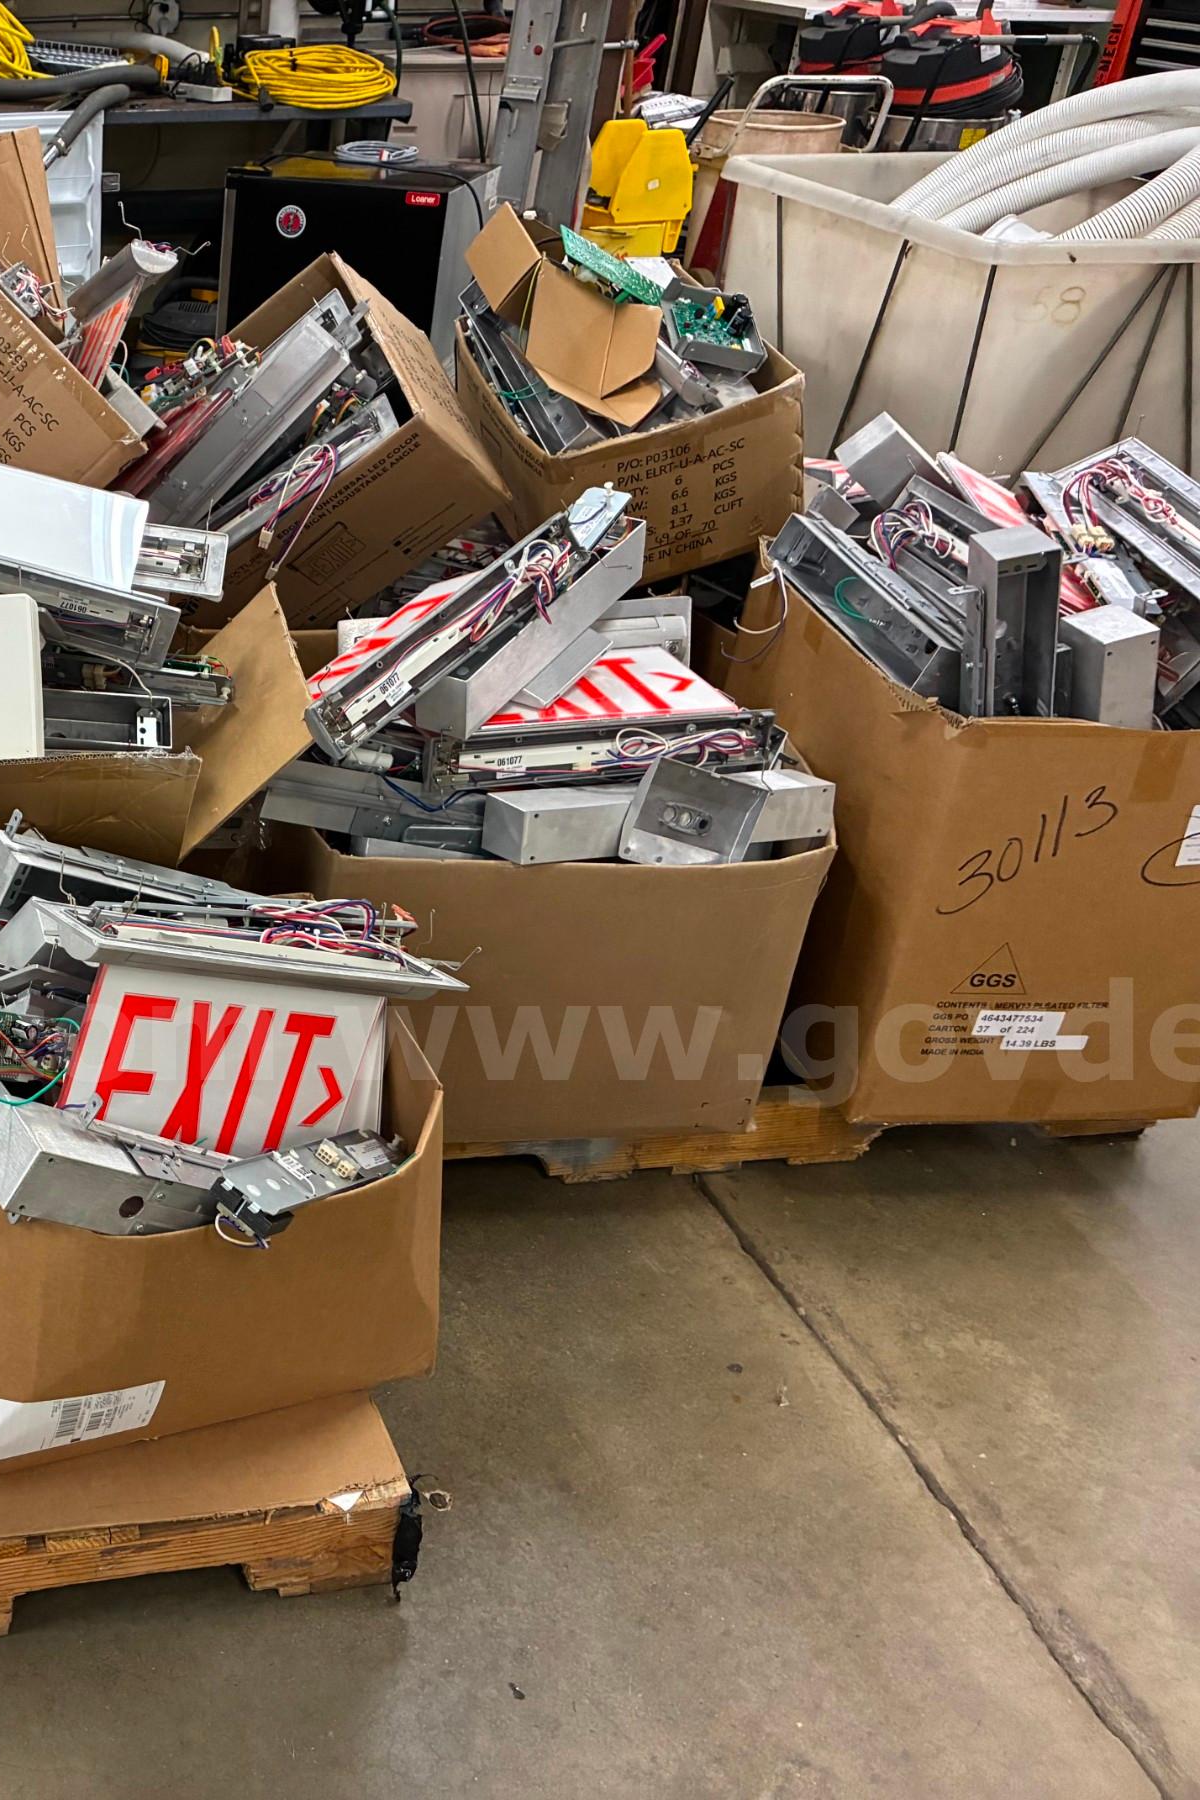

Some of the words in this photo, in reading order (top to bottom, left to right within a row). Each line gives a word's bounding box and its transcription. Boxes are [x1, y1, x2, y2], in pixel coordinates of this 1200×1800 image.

[411, 194, 436, 204] Loaner
[13, 412, 38, 437] PCS
[2, 427, 27, 454] KGS
[367, 458, 386, 473] LED
[386, 431, 419, 460] COLOR
[645, 442, 692, 466] P03106
[332, 465, 389, 512] ADJUSTABLE
[390, 442, 421, 469] ANGLE
[674, 474, 683, 486] 6
[712, 457, 736, 474] PCS
[671, 487, 689, 501] 6.6
[714, 471, 737, 487] KGS
[671, 502, 688, 516] 8.1
[713, 486, 736, 502] KGS
[669, 514, 693, 530] 1.37
[713, 498, 744, 516] CUFT
[675, 528, 692, 541] OF
[701, 519, 716, 532] 70
[658, 547, 671, 560] IN
[675, 535, 713, 555] CHINA
[60, 601, 87, 614] 061077
[380, 672, 400, 694] 061077
[488, 657, 671, 722] IT
[497, 755, 523, 767] 061077
[935, 785, 1118, 915] 30113
[969, 973, 1017, 988] GGS
[936, 1001, 987, 1010] CONTENTS
[928, 1024, 968, 1033] CARTON
[976, 1025, 990, 1034] 37
[1000, 1025, 1013, 1034] of
[1016, 1026, 1035, 1035] 224
[932, 1013, 953, 1021] GGS
[955, 1013, 969, 1021] PO
[980, 1014, 1044, 1023] 4643477534
[920, 1048, 947, 1056] MADE
[960, 1048, 984, 1056] INDIA
[924, 1037, 958, 1045] GROSS
[959, 1037, 995, 1045] WEIGHT
[1033, 1040, 1057, 1048] LBS
[95, 993, 336, 1154] EXIT
